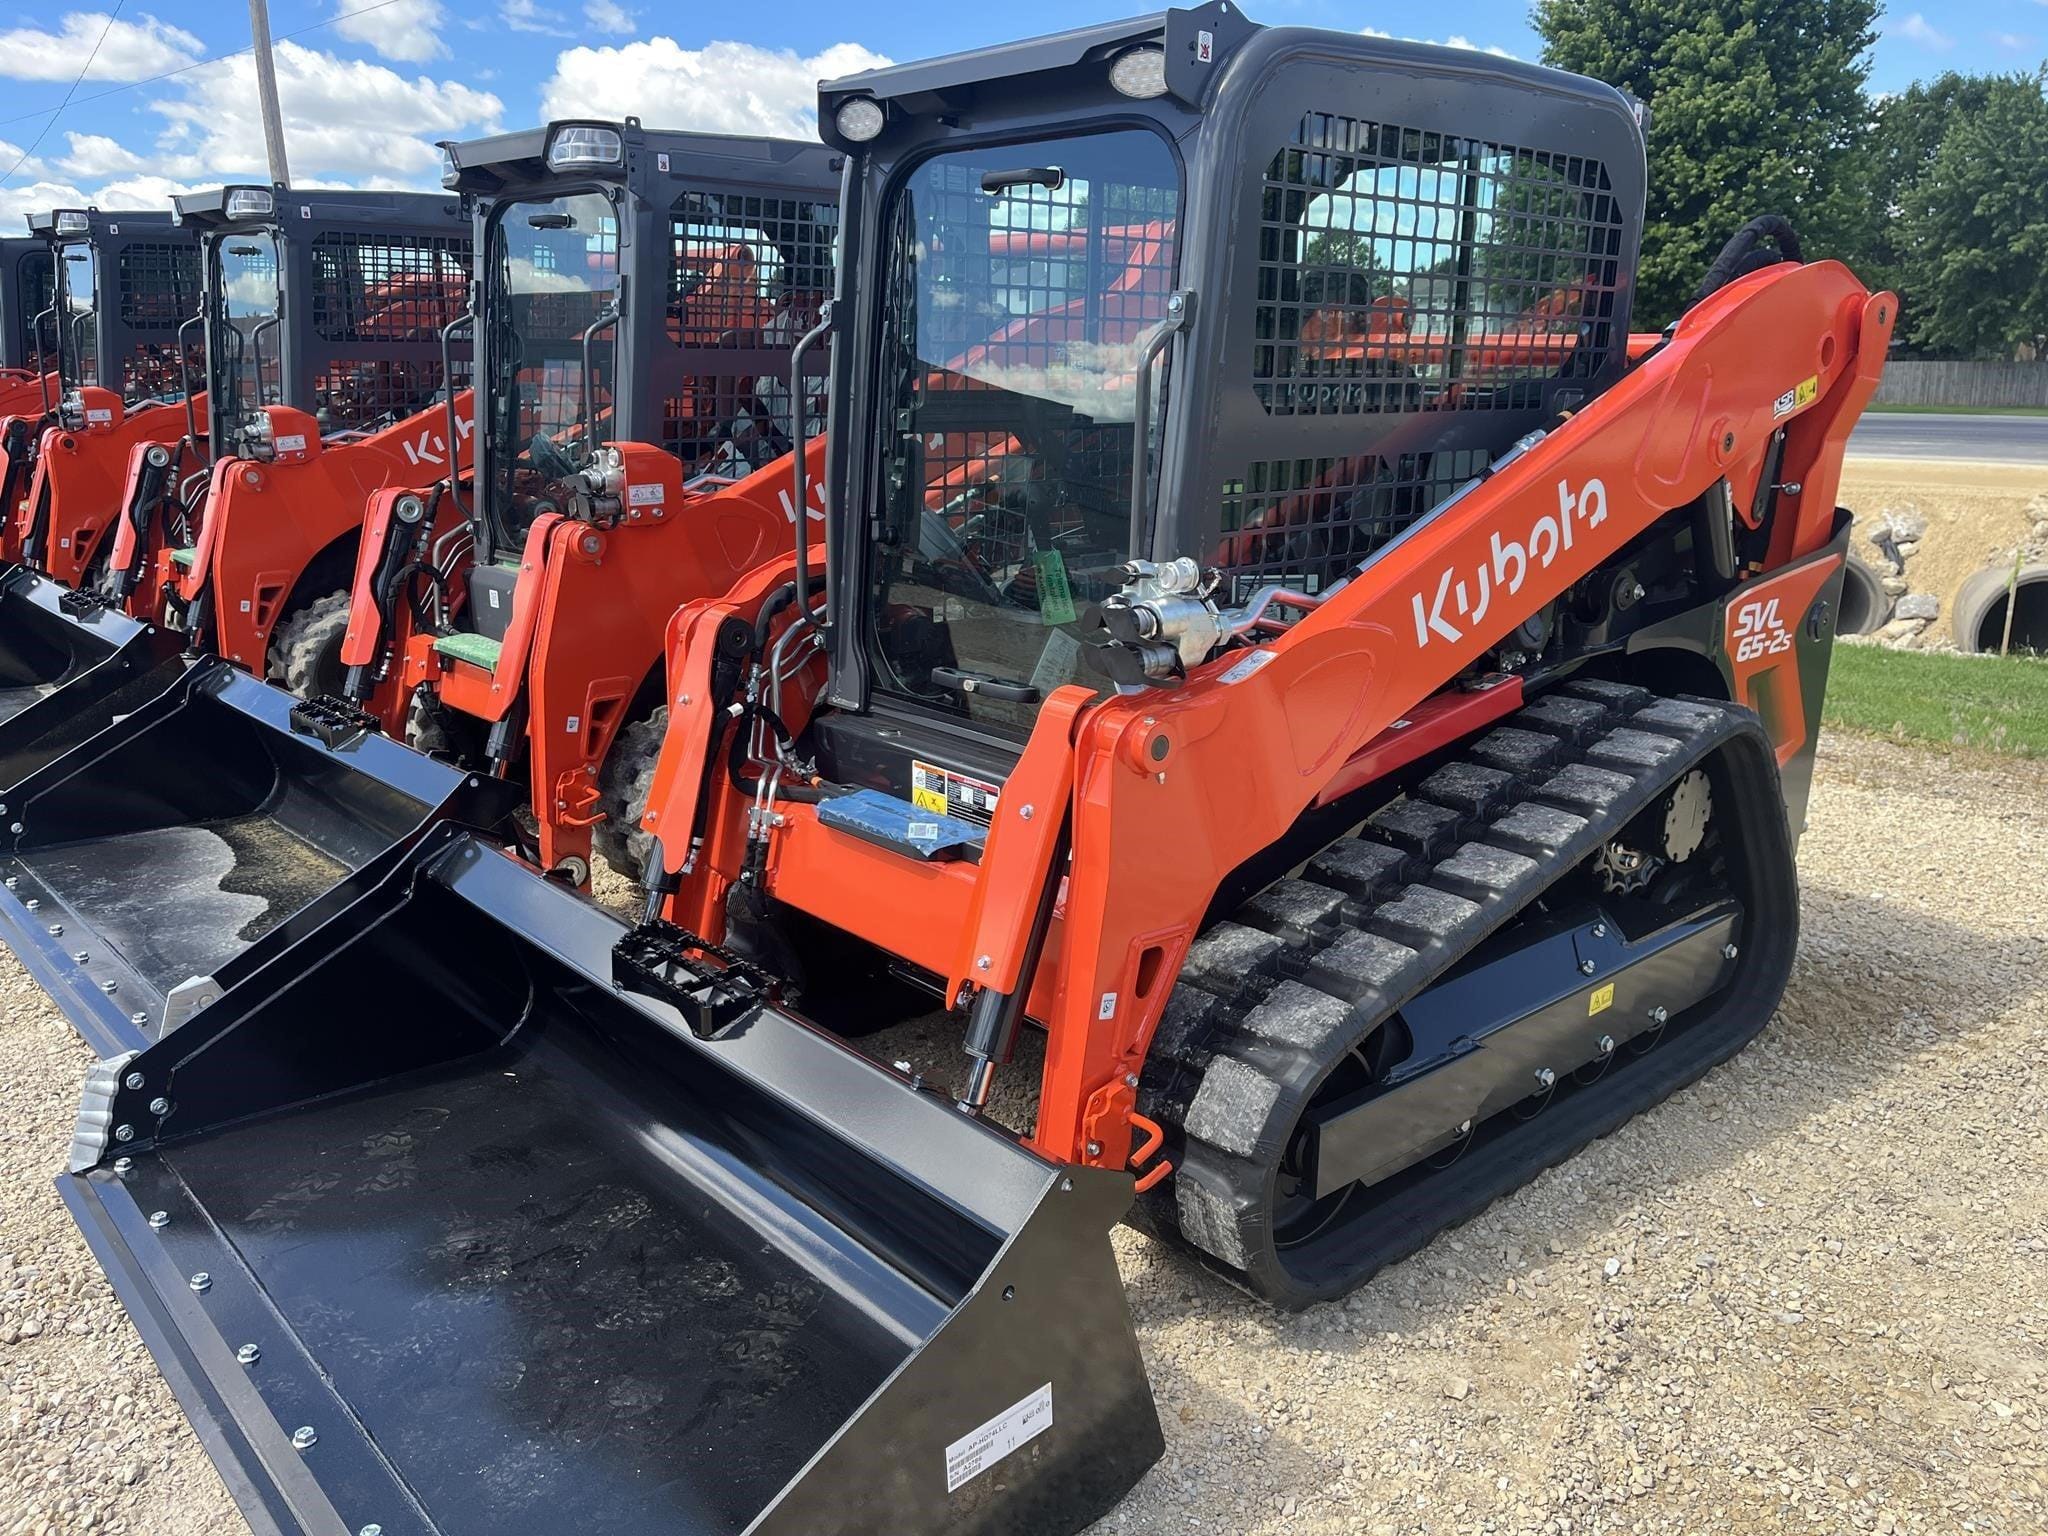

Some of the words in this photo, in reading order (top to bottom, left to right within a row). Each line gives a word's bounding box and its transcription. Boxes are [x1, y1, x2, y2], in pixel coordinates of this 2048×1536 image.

[1774, 389, 1795, 415] KSR
[1411, 478, 1608, 649] Kubota
[1732, 598, 1784, 638] SVL
